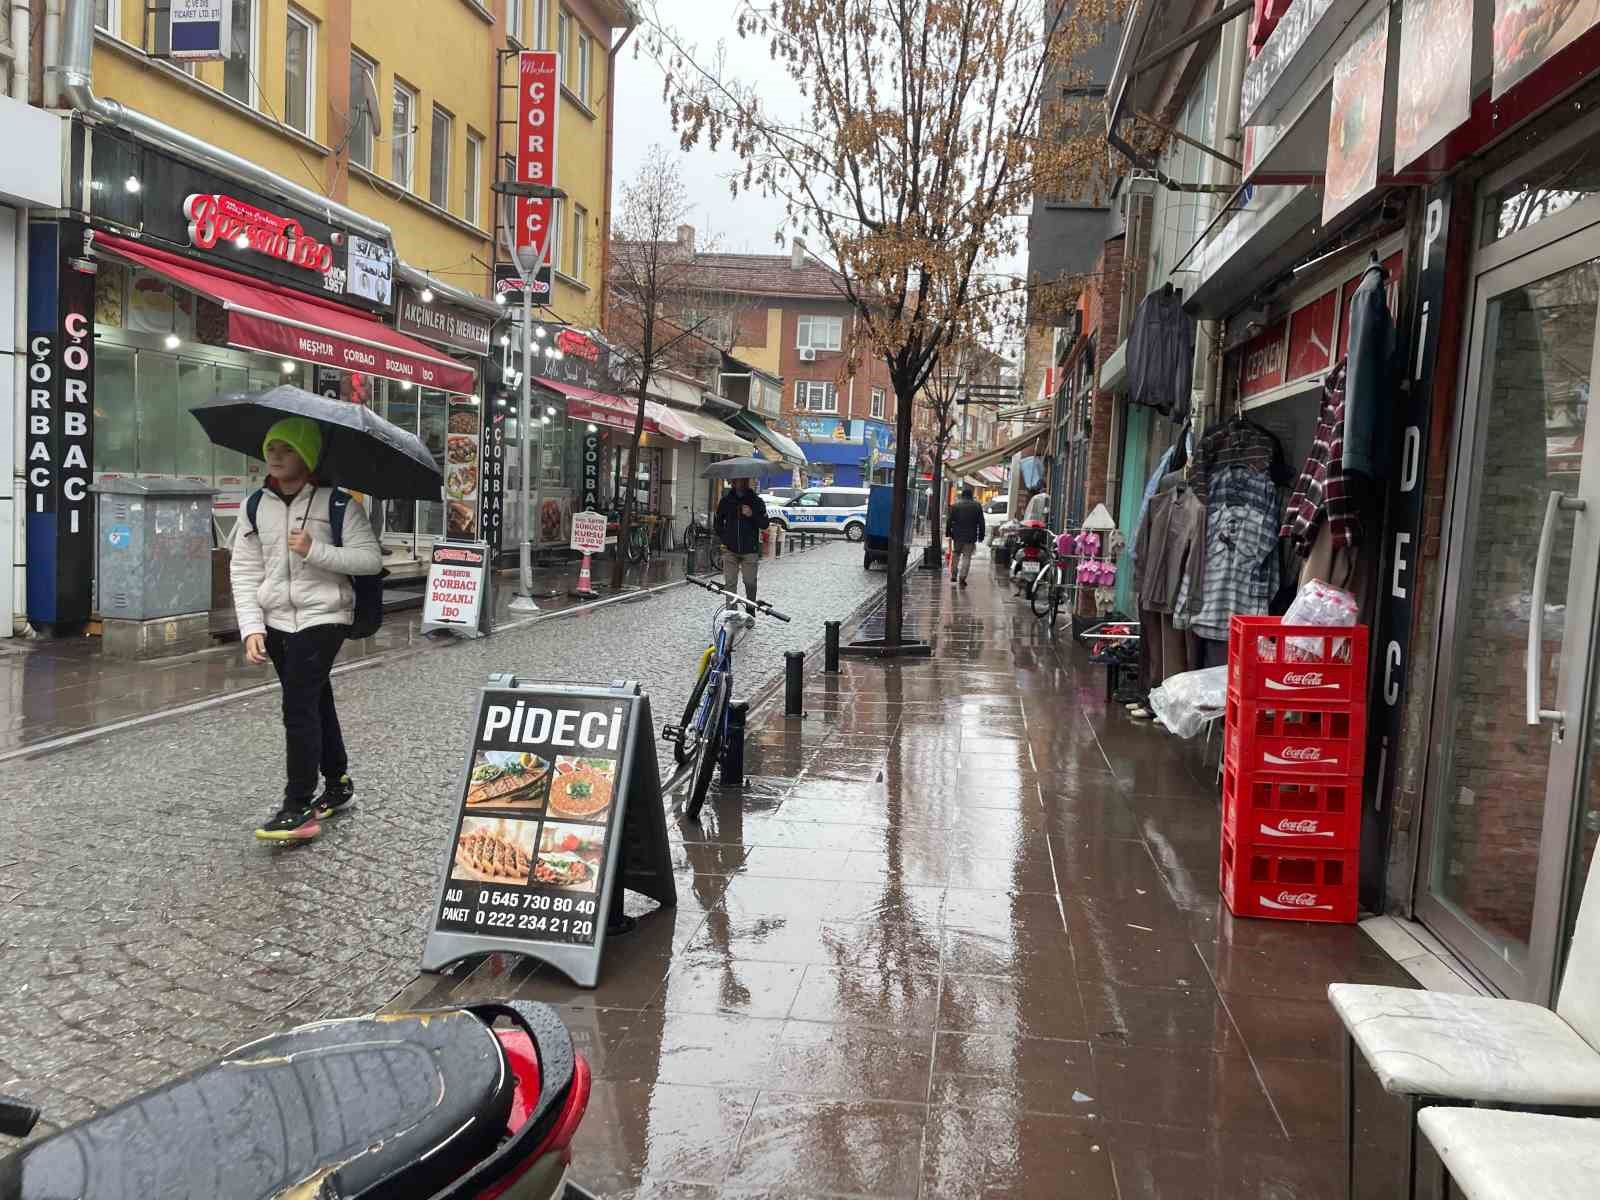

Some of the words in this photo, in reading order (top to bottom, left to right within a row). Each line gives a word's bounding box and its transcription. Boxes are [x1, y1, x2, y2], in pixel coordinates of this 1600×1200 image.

[404, 303, 446, 332] AKÇİNLER
[298, 337, 335, 357] MEŞHUR
[343, 348, 376, 367] ÇORBACI
[385, 359, 414, 376] BOZANLI
[29, 336, 52, 513] ÇORBACI
[62, 312, 88, 534] ÇORBACI
[492, 427, 502, 544] ÇORBACI
[1374, 198, 1443, 813] PİDECİ
[574, 529, 604, 539] KURSU
[431, 591, 475, 605] BOZANLI
[432, 578, 477, 592] ÇORBACI
[441, 604, 460, 617] İBO
[482, 699, 624, 751] PİDECİ
[445, 888, 463, 903] ALO
[479, 890, 489, 905] 0
[491, 891, 520, 908] 545
[522, 894, 551, 911] 730
[552, 897, 573, 913] 80
[575, 899, 596, 915] 40
[442, 907, 470, 922] PAKET
[475, 910, 486, 926] 0
[487, 911, 515, 928] 222
[517, 914, 548, 931] 234
[549, 917, 569, 933] 21
[571, 920, 593, 936] 20
